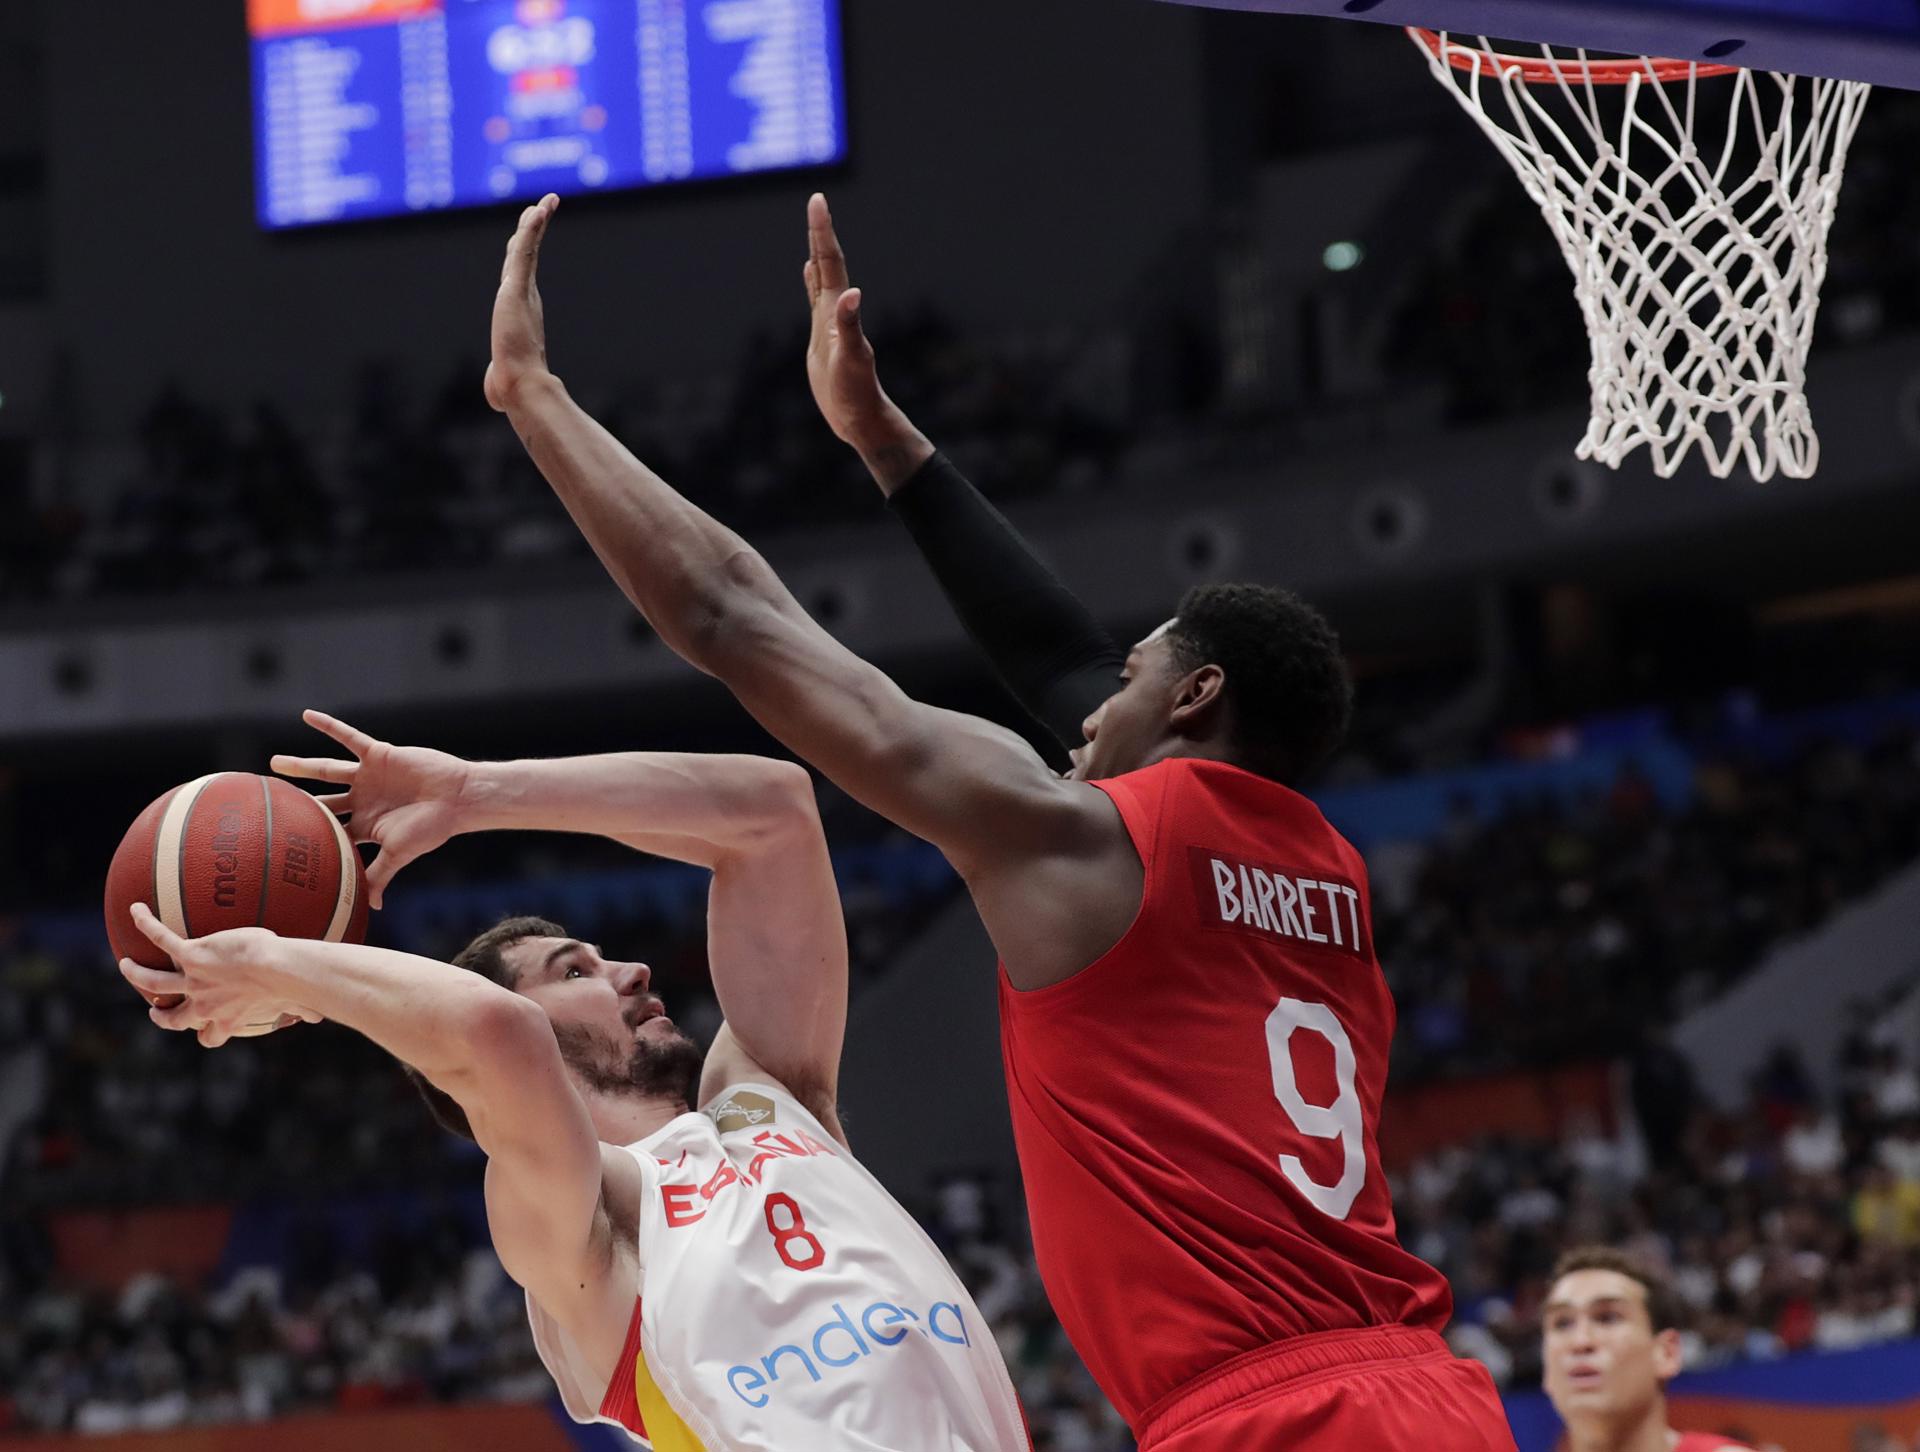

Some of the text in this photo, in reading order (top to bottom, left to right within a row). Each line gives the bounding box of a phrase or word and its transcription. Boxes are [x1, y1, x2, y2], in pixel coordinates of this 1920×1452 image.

[211, 802, 241, 908] molten
[282, 832, 310, 889] FIBA
[1211, 859, 1360, 951] BARRETT
[1265, 997, 1366, 1220] 9
[660, 1129, 838, 1228] ESAÑA
[764, 1192, 826, 1271] 8
